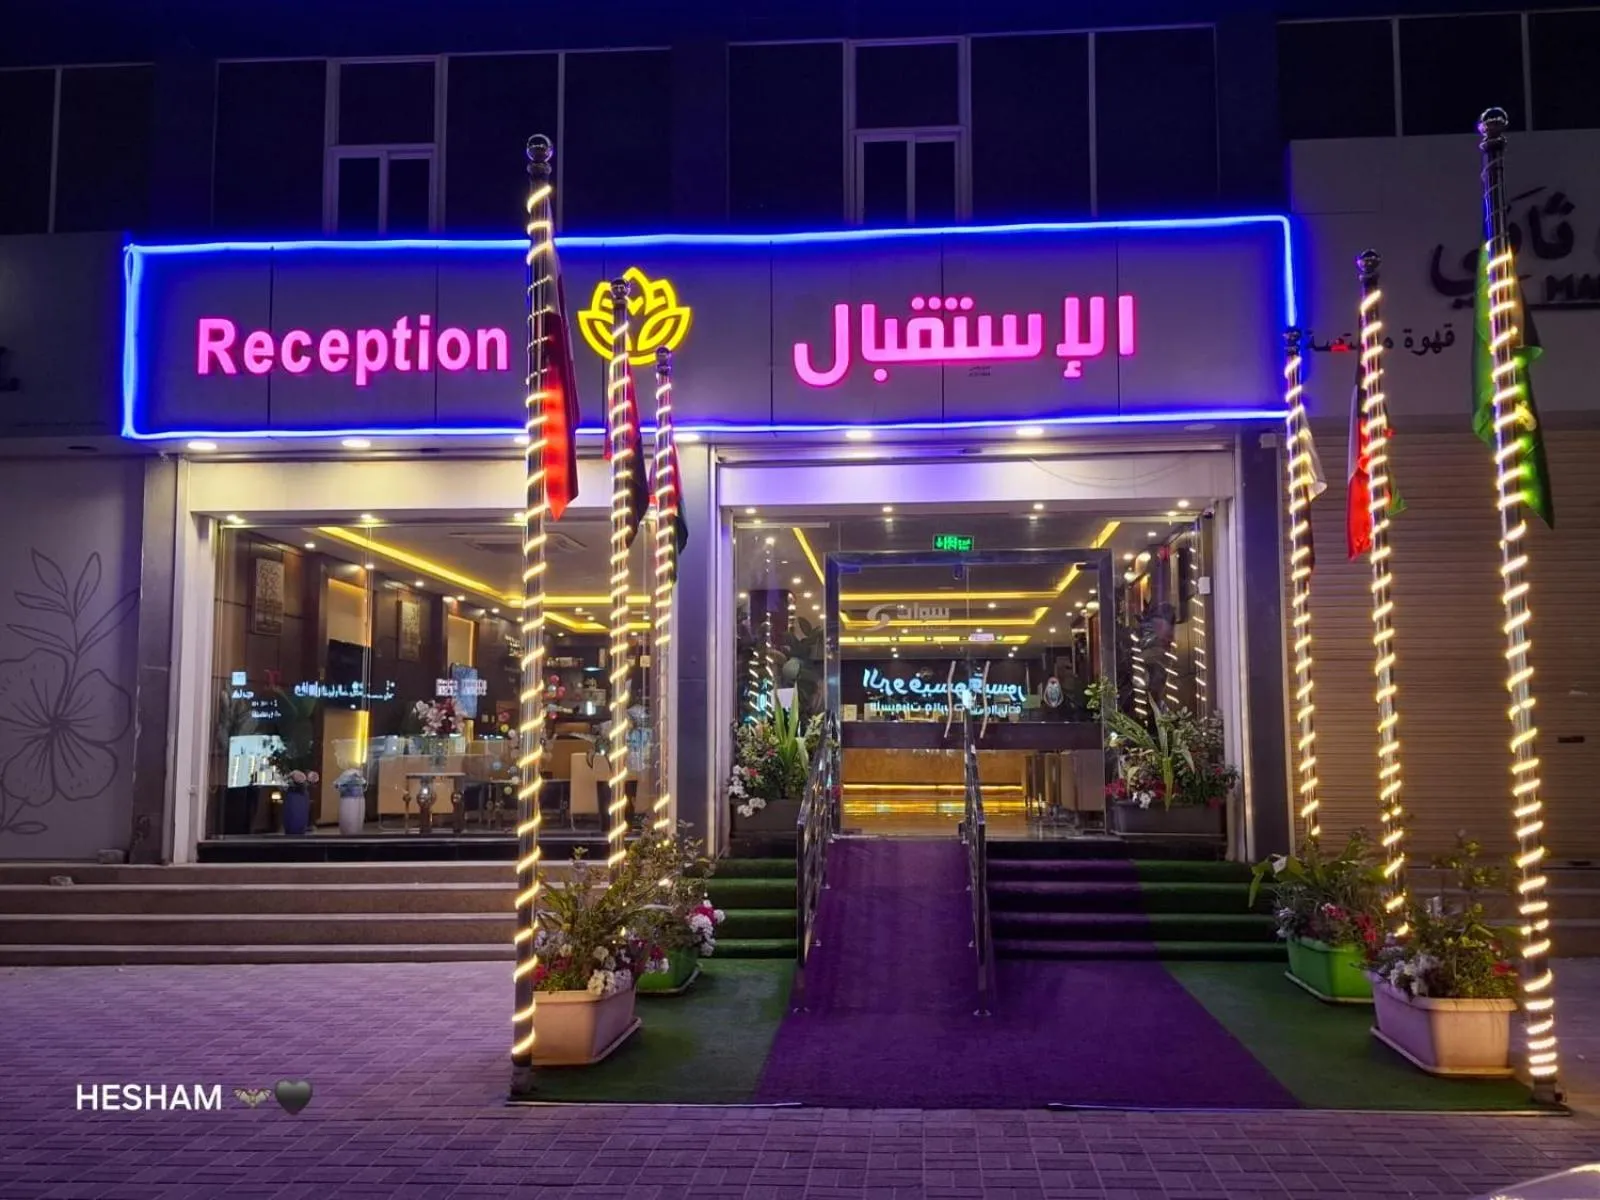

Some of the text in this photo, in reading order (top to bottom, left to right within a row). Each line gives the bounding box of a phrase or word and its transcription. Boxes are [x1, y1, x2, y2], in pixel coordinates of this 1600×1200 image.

[196, 313, 510, 387] Reception
[793, 294, 1136, 388] الإستقبال
[1403, 323, 1456, 356] قهوة
